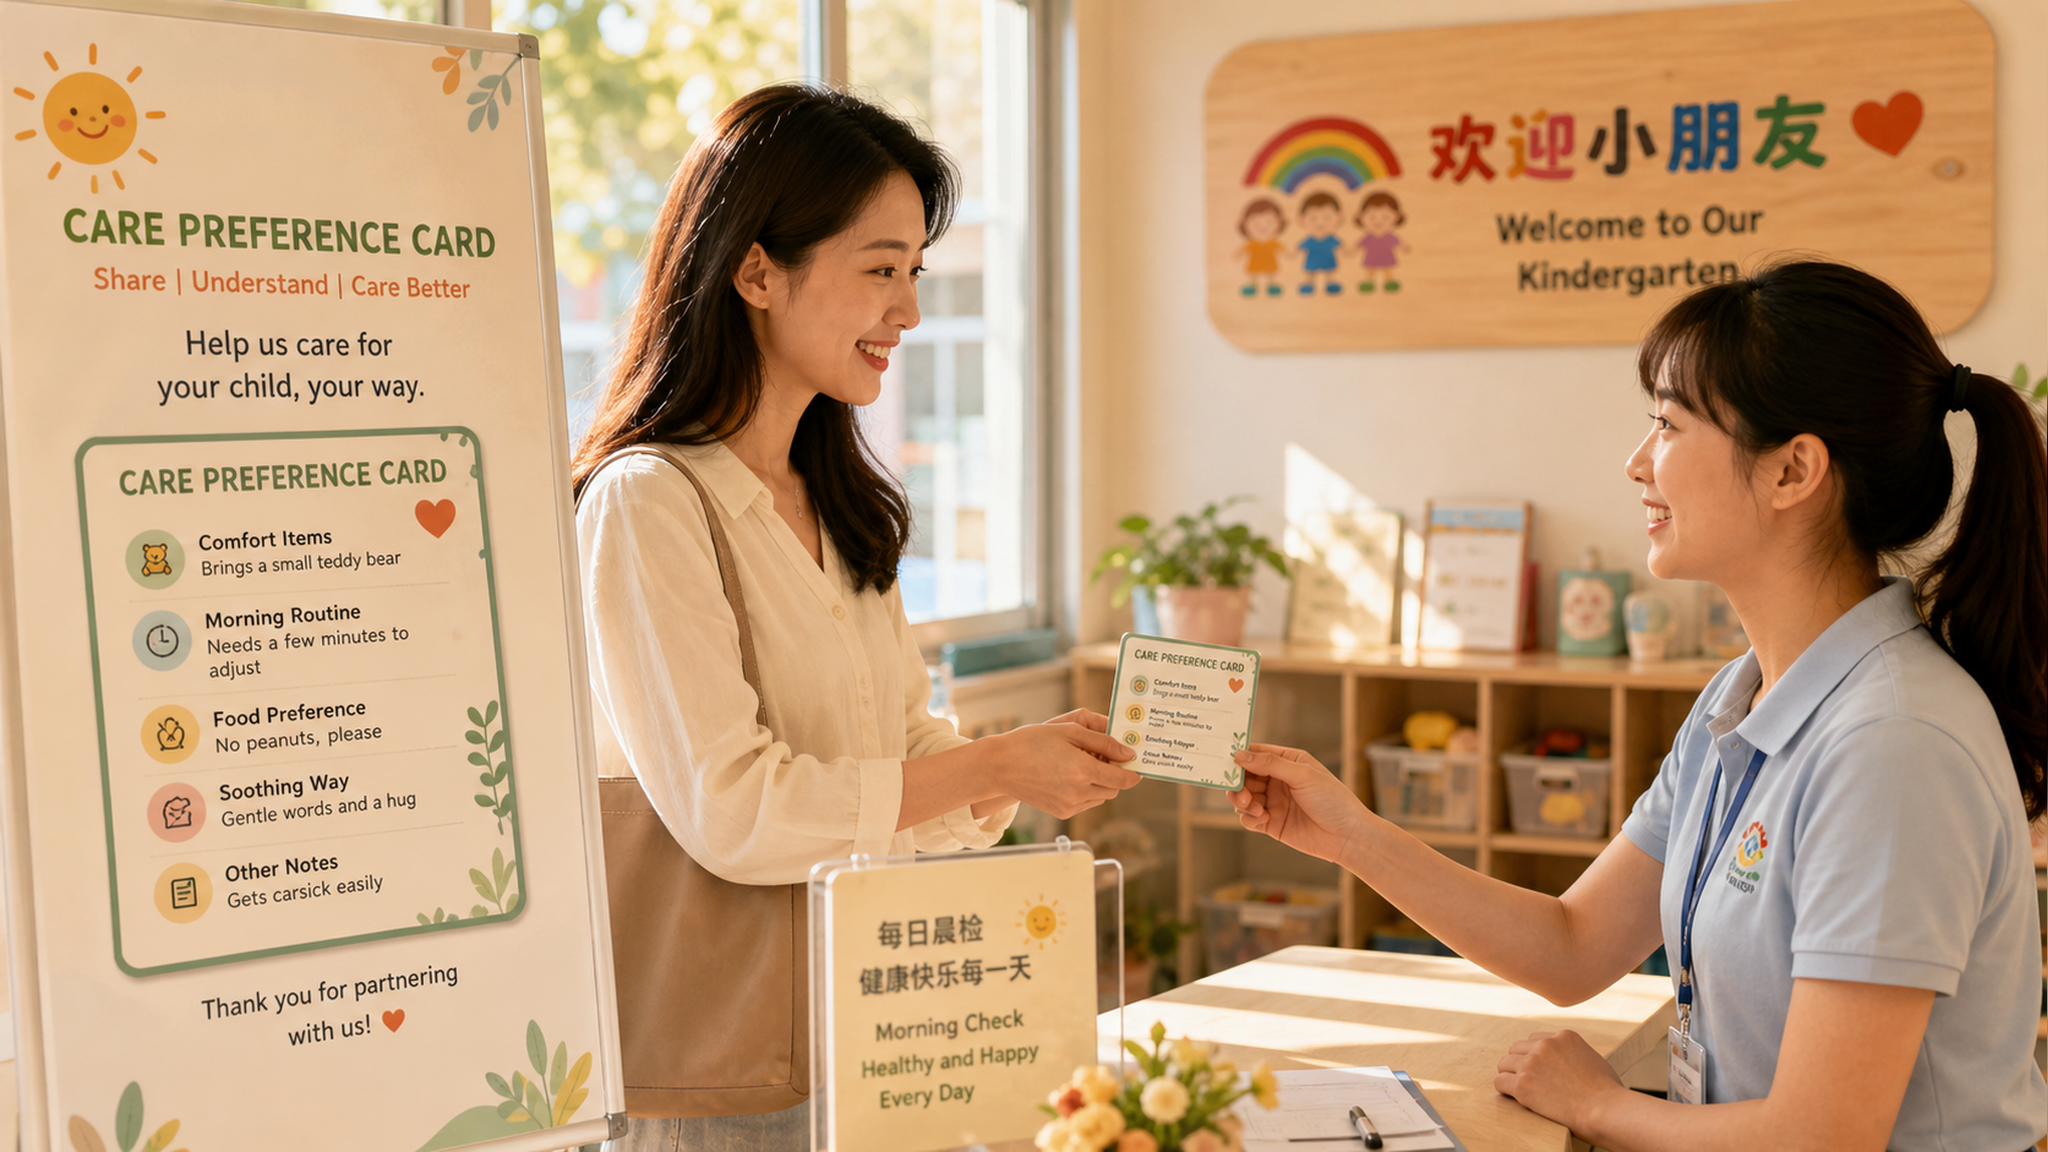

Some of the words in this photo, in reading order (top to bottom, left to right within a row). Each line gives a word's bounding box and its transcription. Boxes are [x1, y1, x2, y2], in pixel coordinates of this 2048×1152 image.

[1428, 94, 1828, 184] 欢迎小朋友
[63, 207, 165, 246] CARE
[178, 212, 401, 255] PREFERENCE
[411, 223, 496, 258] CARD
[1495, 211, 1645, 243] Welcome
[1656, 207, 1692, 238] to
[1702, 204, 1765, 236] Our
[93, 266, 166, 292] Share
[192, 269, 329, 296] Understand
[351, 274, 401, 298] Care
[407, 276, 471, 299] Better
[1518, 257, 1738, 297] Kindergarten
[186, 329, 250, 363] Help
[258, 337, 288, 356] us
[296, 337, 350, 357] care
[357, 331, 393, 357] for
[156, 380, 221, 407] your
[229, 372, 300, 403] child,
[307, 379, 364, 405] your
[371, 379, 425, 404] way.
[119, 467, 194, 496] CARE
[203, 461, 372, 493] PREFERENCE
[379, 458, 447, 485] CARD
[198, 531, 277, 552] Comfort
[282, 530, 333, 547] Items
[201, 559, 254, 579] Brings
[257, 561, 268, 573] a
[272, 554, 313, 573] small
[316, 552, 362, 572] teddy
[366, 551, 402, 567] bear
[205, 608, 284, 630] Morning
[290, 604, 361, 624] Routine
[207, 635, 263, 655] Needs
[268, 638, 279, 651] a
[283, 632, 316, 649] few
[321, 629, 387, 646] minutes
[391, 626, 409, 641] to
[209, 659, 262, 681] adjust
[1134, 648, 1159, 662] CARE
[1160, 651, 1218, 671] PREFERENCE
[1219, 660, 1245, 674] CARD
[213, 707, 261, 728] Food
[266, 702, 366, 724] Preference
[215, 737, 241, 754] No
[246, 730, 320, 755] peanuts,
[327, 726, 382, 747] please
[219, 778, 304, 802] Soothing
[309, 773, 350, 793] Way
[221, 806, 278, 827] Gentle
[282, 799, 333, 820] words
[338, 795, 368, 814] and
[372, 797, 382, 810] a
[386, 792, 417, 810] hug
[225, 862, 280, 883] Other
[285, 856, 339, 875] Notes
[227, 890, 268, 909] Gets
[272, 880, 332, 903] carsick
[336, 874, 383, 895] easily
[878, 913, 984, 950] 每日晨检
[859, 954, 1032, 996] 健康快乐每一天
[200, 991, 269, 1020] Thank
[274, 989, 312, 1015] you
[317, 980, 348, 1002] for
[354, 965, 458, 1002] partnering
[287, 1020, 334, 1047] with
[341, 1013, 371, 1038] us!
[875, 1017, 959, 1042] Morning
[964, 1009, 1024, 1033] Check
[861, 1053, 935, 1079] Healthy
[940, 1048, 975, 1069] and
[980, 1044, 1039, 1067] Happy
[879, 1088, 933, 1109] Every
[939, 1082, 976, 1104] Day
